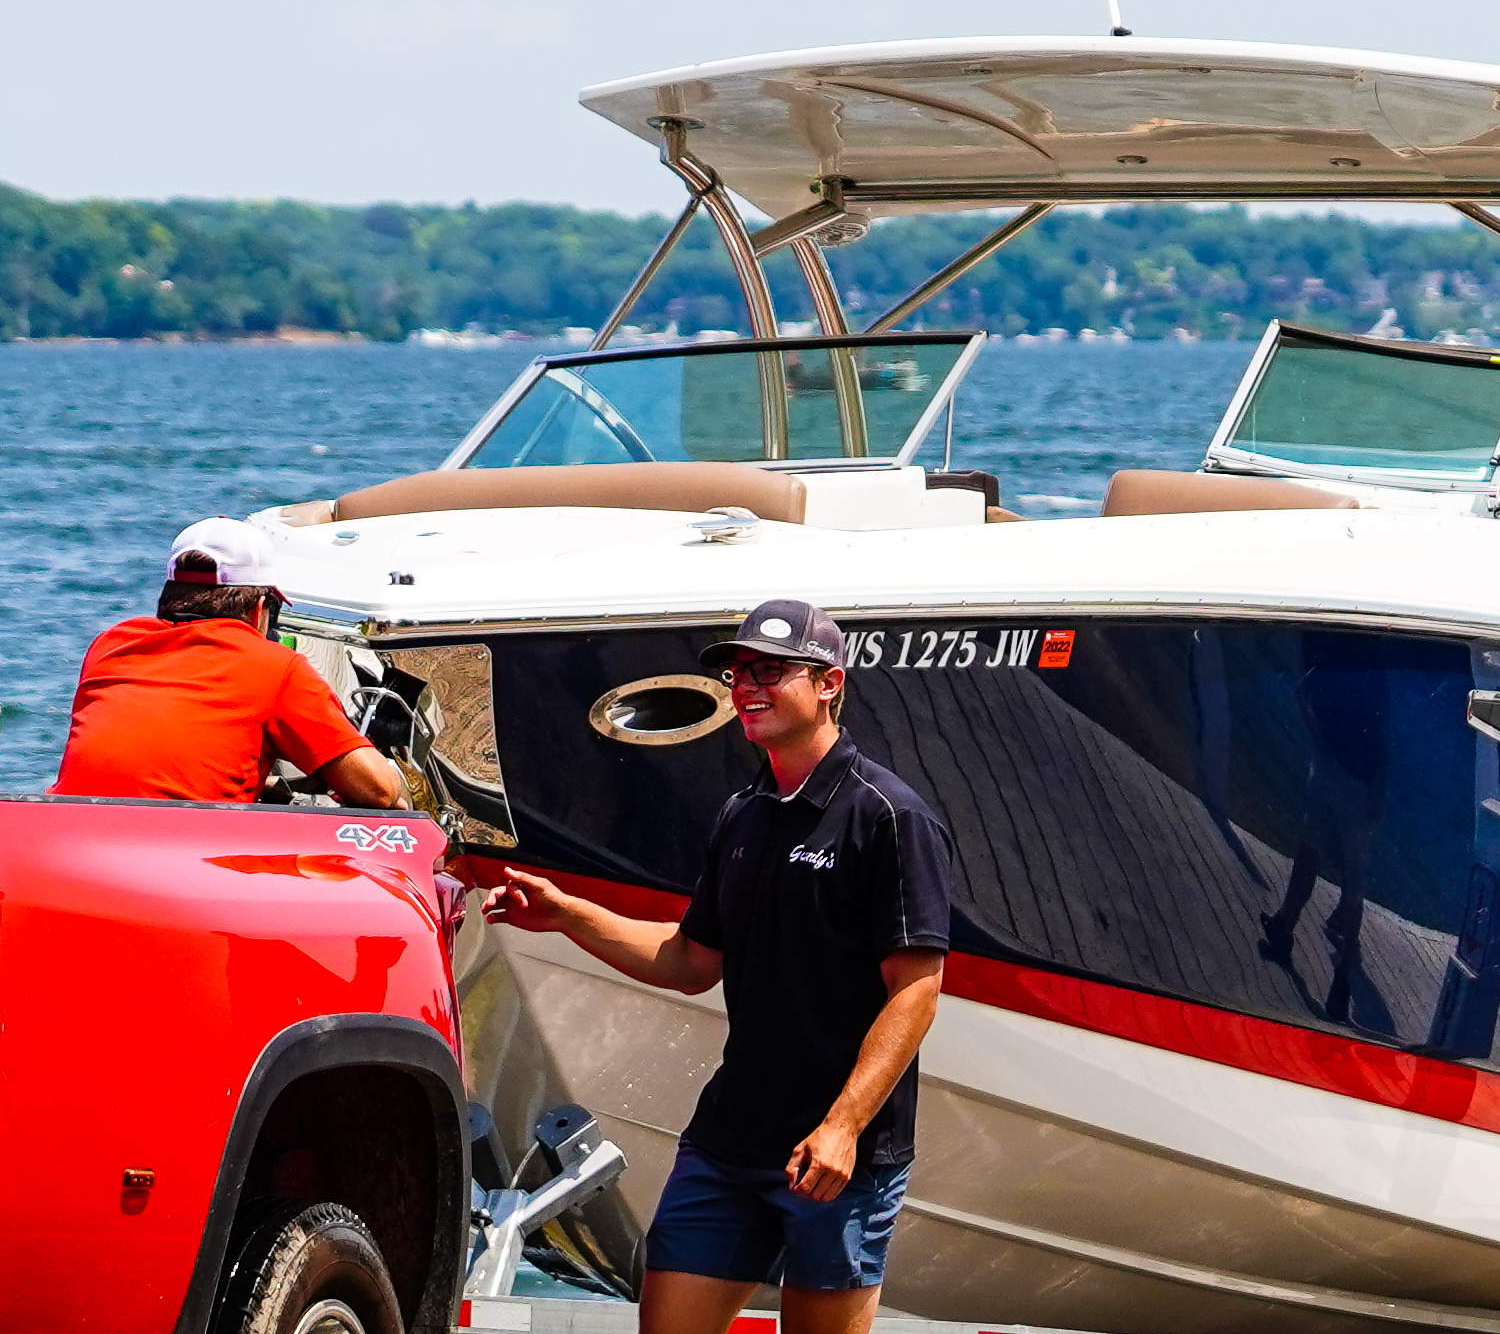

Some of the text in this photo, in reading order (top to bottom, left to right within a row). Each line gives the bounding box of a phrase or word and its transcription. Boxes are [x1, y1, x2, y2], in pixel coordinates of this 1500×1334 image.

[891, 631, 978, 667] 1275
[985, 629, 1039, 667] JW
[1043, 641, 1071, 652] 2022
